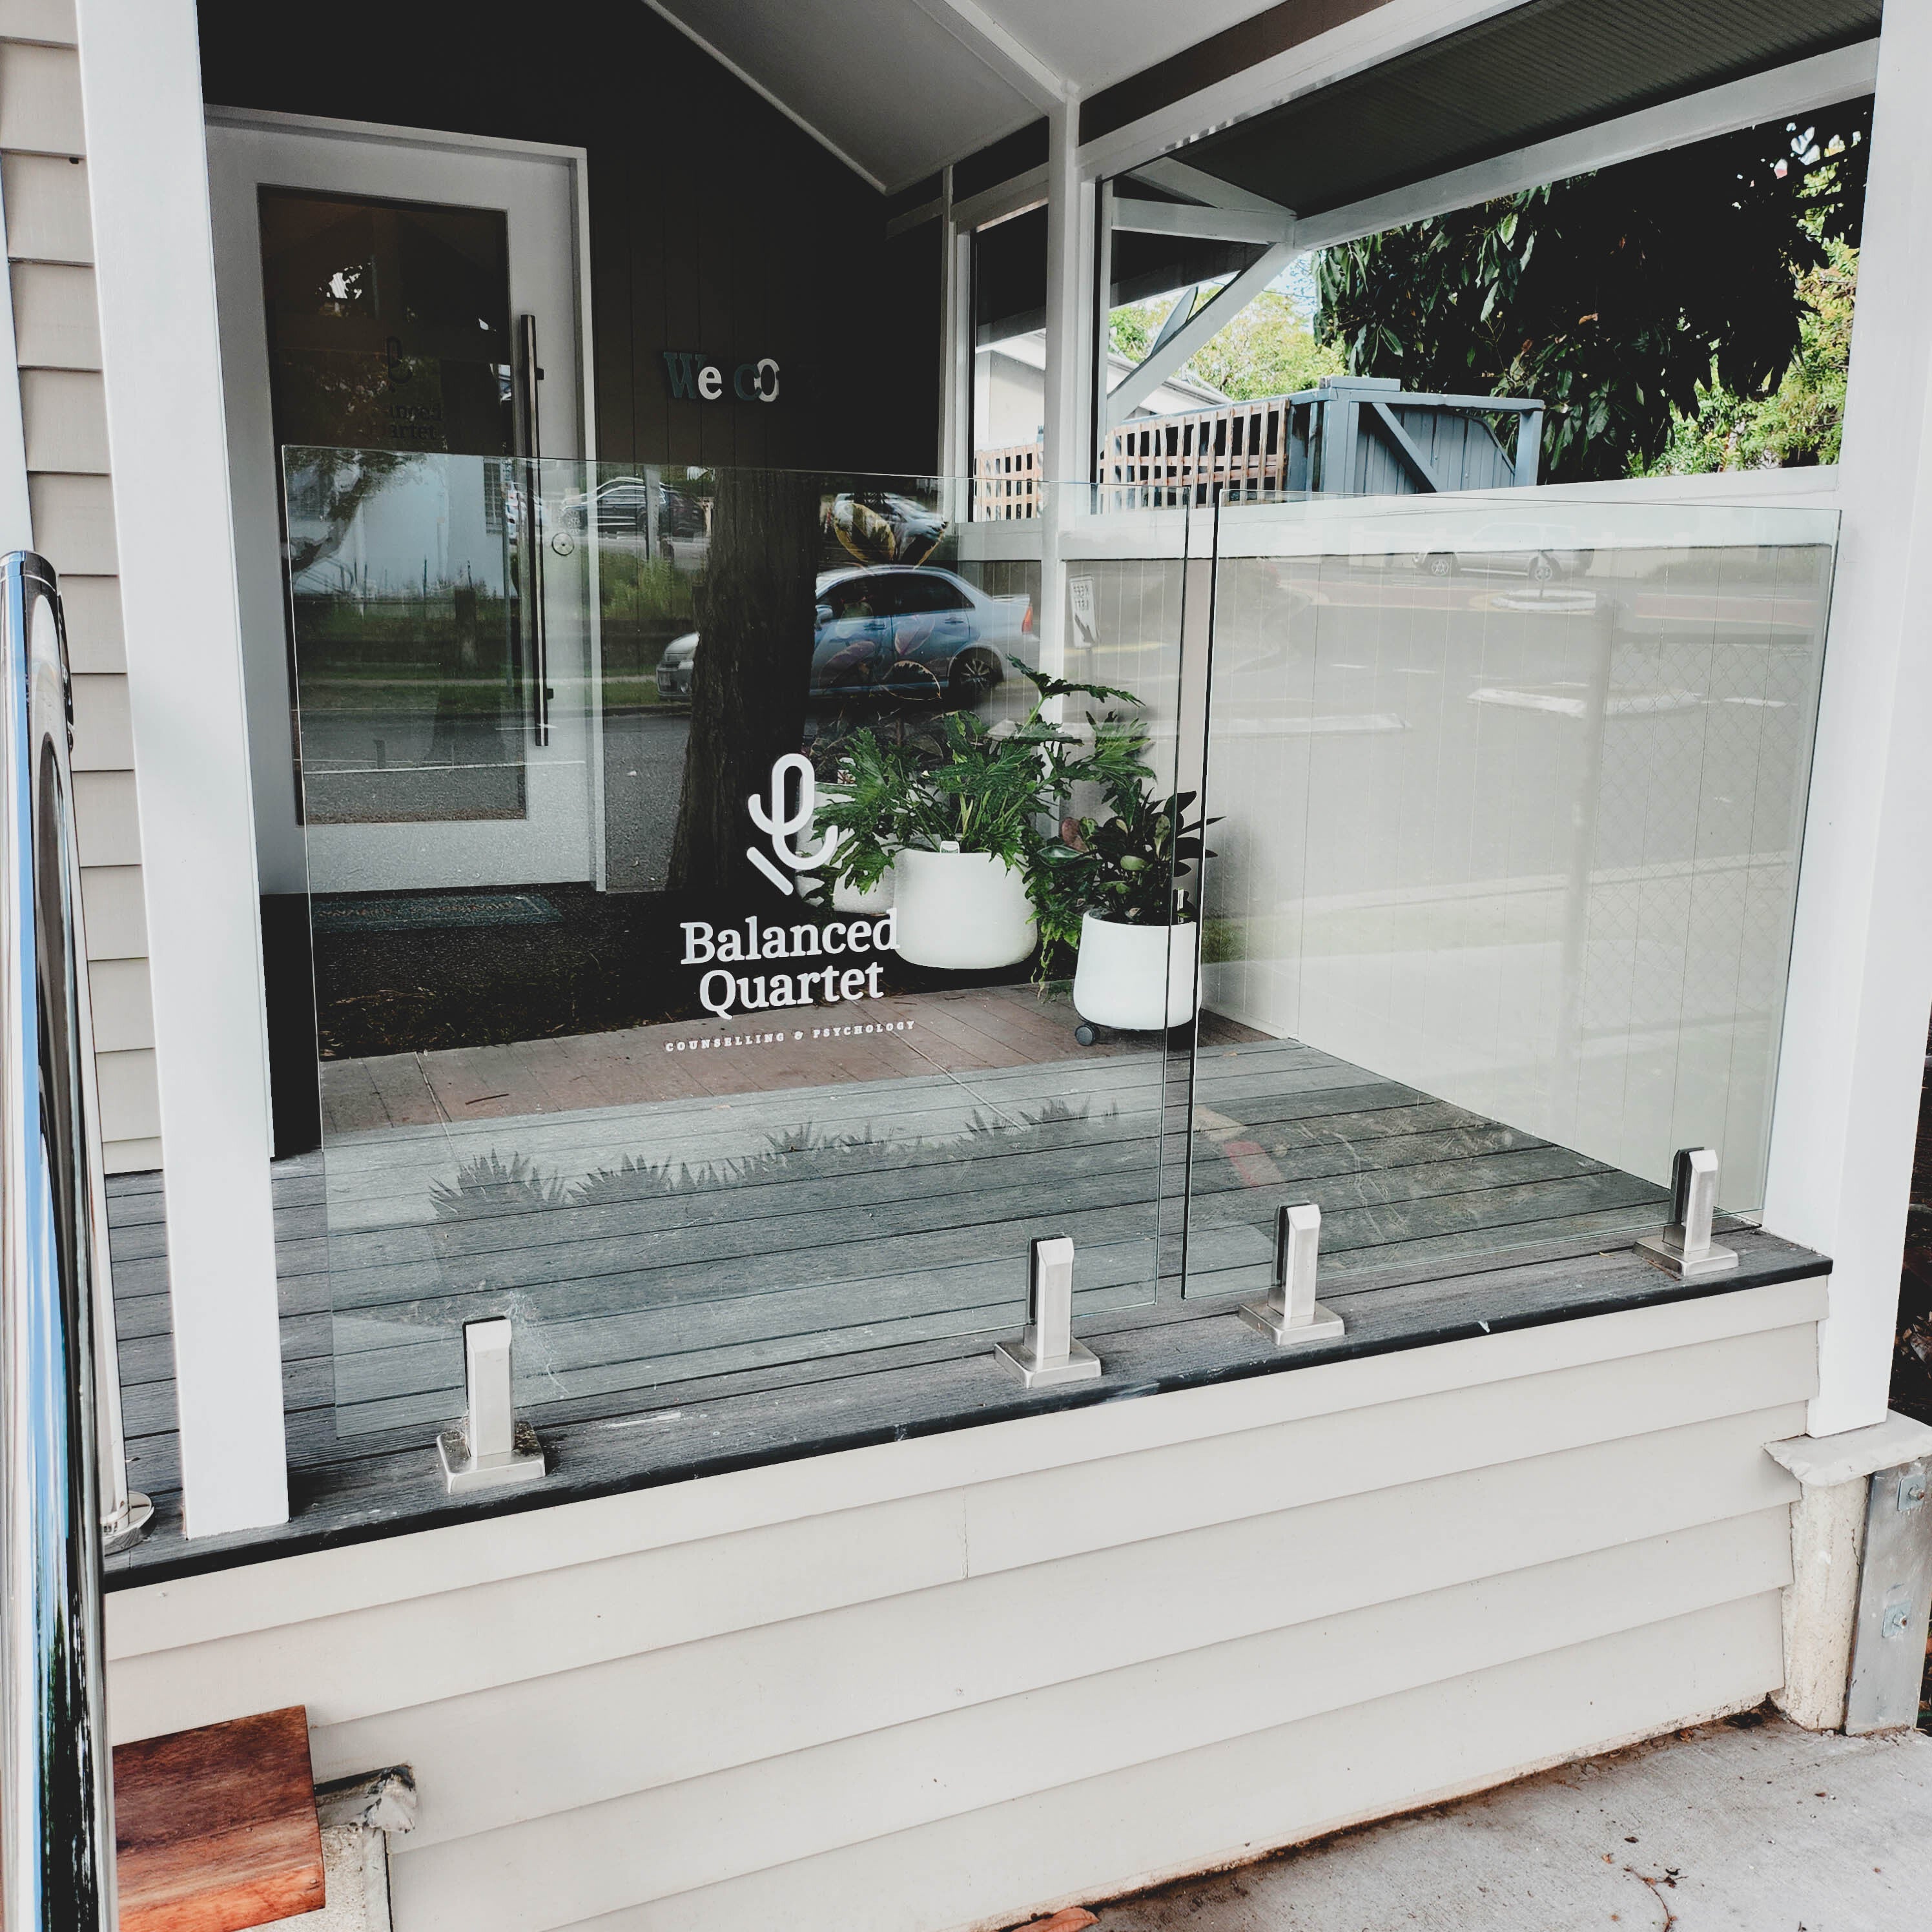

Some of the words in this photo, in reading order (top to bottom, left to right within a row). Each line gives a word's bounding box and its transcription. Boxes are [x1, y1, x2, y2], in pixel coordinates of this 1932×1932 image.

[679, 907, 900, 965] Balanced
[699, 961, 884, 1020] Quartet
[665, 1033, 784, 1052] COUNSELLING
[813, 1020, 916, 1038] PSYCHOLOGY
